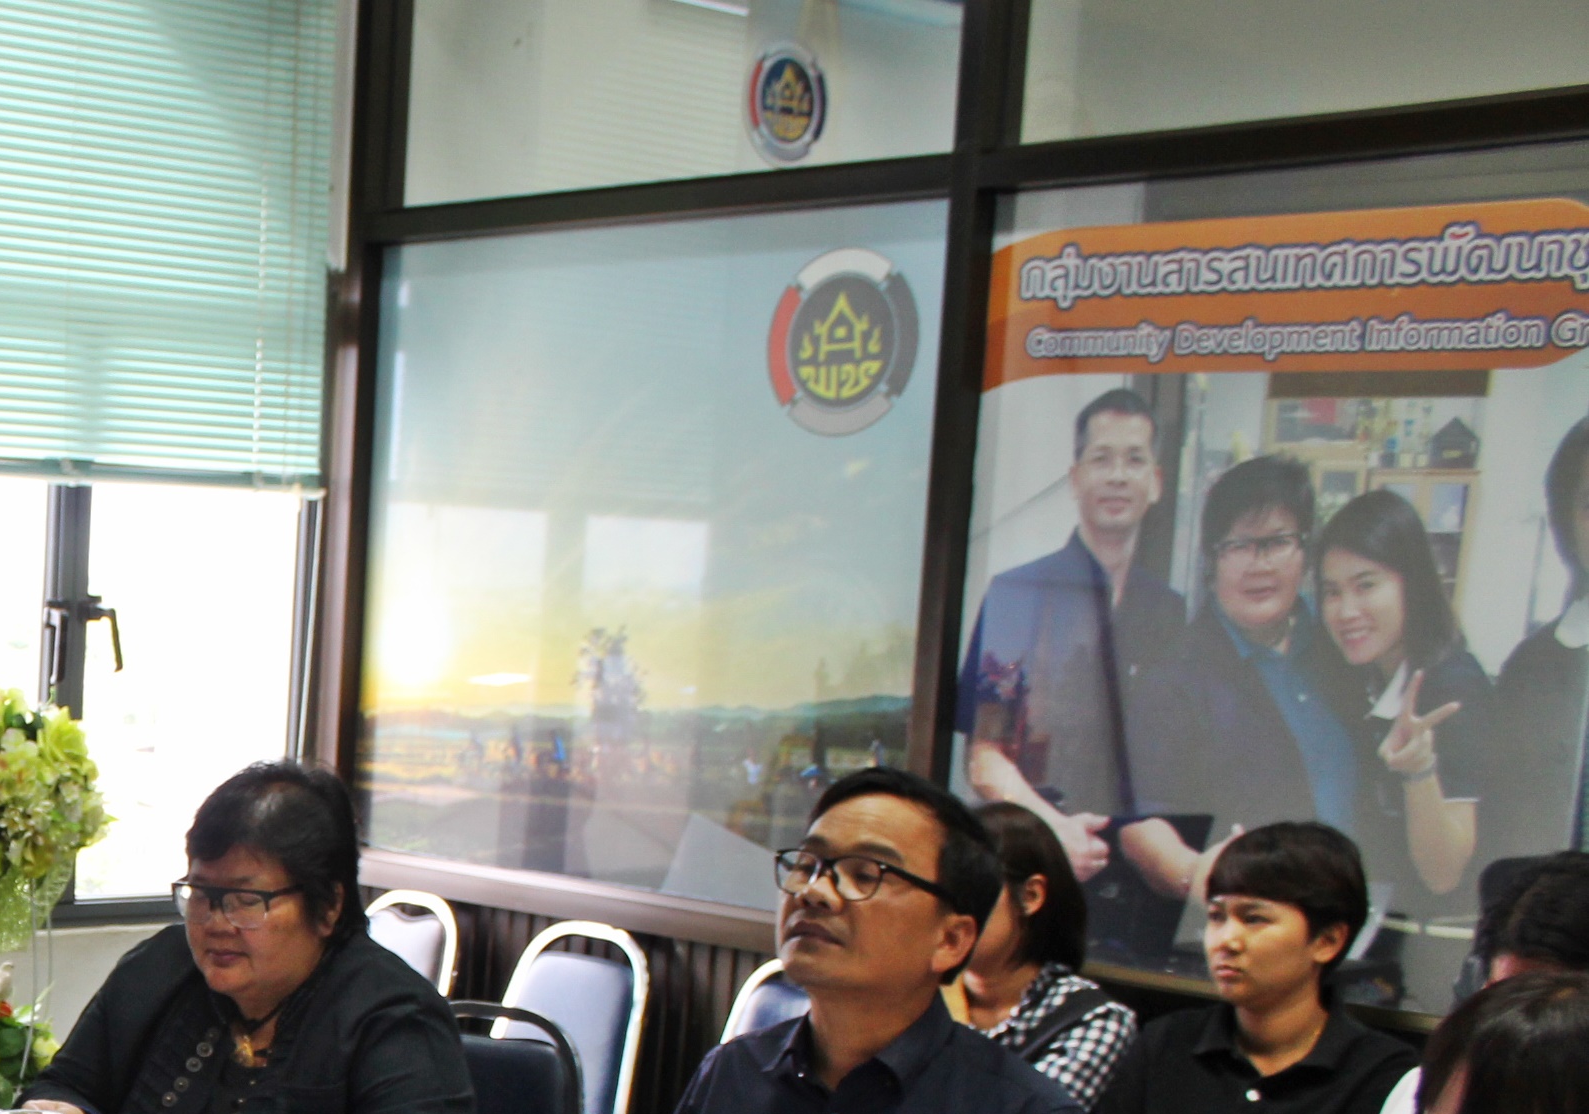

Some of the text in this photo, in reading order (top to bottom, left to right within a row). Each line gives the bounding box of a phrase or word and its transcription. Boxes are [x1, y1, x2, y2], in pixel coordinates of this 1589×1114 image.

[1026, 317, 1171, 364] Community
[1174, 316, 1361, 361] Development
[1364, 312, 1548, 351] Information
